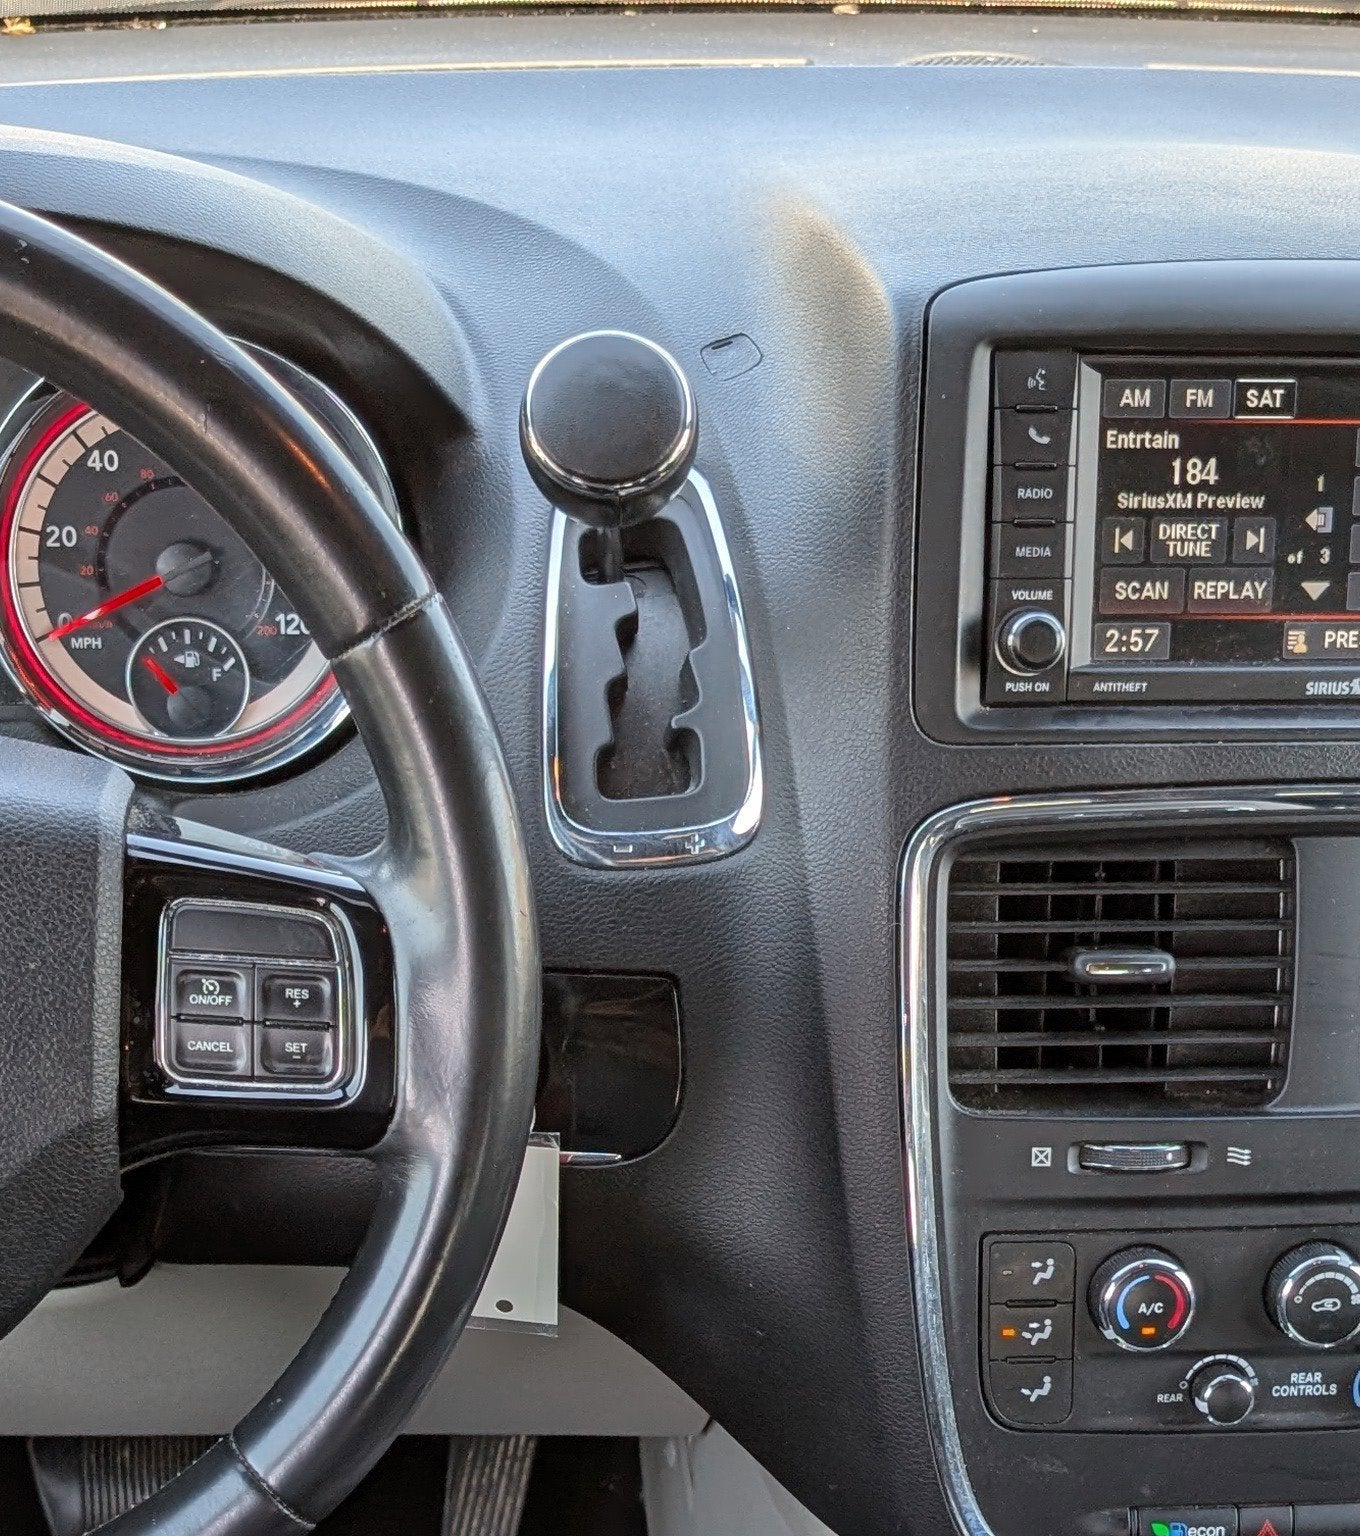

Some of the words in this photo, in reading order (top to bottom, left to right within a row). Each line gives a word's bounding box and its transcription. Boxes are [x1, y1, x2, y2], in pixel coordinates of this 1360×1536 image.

[1120, 389, 1151, 408] AM
[1186, 389, 1214, 408] FM
[1246, 389, 1285, 408] SAT
[1106, 429, 1180, 449] Entrtain
[87, 450, 119, 471] 40
[1172, 457, 1219, 485] 184
[1317, 473, 1325, 492] 1
[1017, 488, 1053, 500] RADIO
[1117, 492, 1192, 510] SiriusXM
[1197, 492, 1265, 510] Preview
[46, 525, 77, 548] 20
[1158, 524, 1220, 540] DIRECT
[1015, 546, 1052, 558] MEDIA
[1166, 541, 1212, 557] TUNE
[1287, 550, 1304, 564] of
[1319, 548, 1330, 564] 3
[1011, 589, 1053, 600] VOLUME
[1115, 581, 1169, 600] SCAN
[1193, 581, 1267, 600] REPLAY
[71, 637, 102, 649] MPH
[1104, 629, 1160, 653] 2:57
[212, 668, 222, 681] F
[1005, 682, 1032, 692] PUSH
[1034, 682, 1050, 692] ON
[1092, 682, 1147, 692] ANTITHEFT
[1305, 681, 1350, 696] SIRIUS
[189, 994, 233, 1006] ON/OFF
[285, 988, 309, 999] RES
[187, 1041, 233, 1053] CANCEL
[285, 1043, 308, 1053] SET
[1138, 1302, 1164, 1315] A/C
[1290, 1372, 1322, 1384] REAR
[1157, 1393, 1183, 1403] REAR
[1271, 1384, 1337, 1397] CONTROLS
